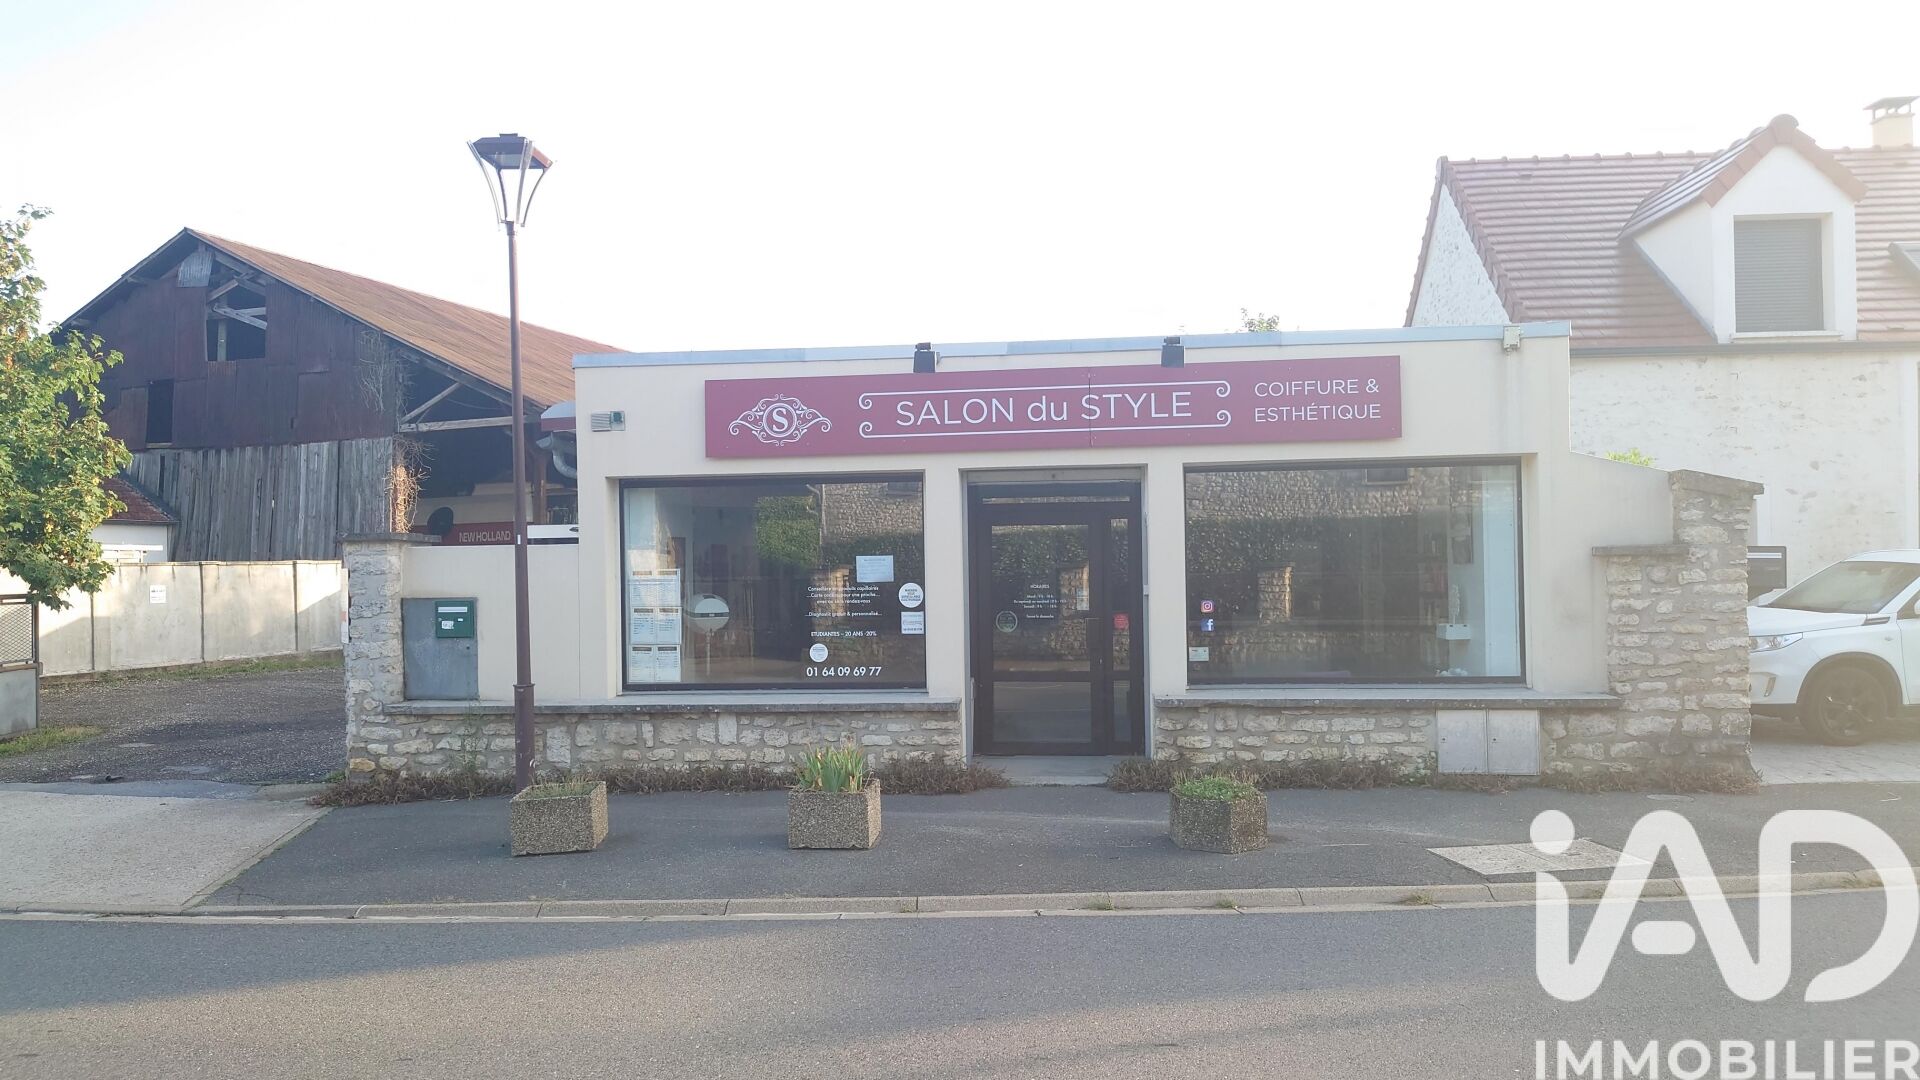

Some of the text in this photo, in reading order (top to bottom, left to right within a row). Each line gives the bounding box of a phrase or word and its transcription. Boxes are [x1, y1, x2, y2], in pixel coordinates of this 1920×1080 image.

[1254, 378, 1380, 397] COIFFURE &
[896, 391, 1192, 426] SALON du STYLE
[1254, 402, 1382, 422] ESTHÉTIQUE
[459, 530, 511, 542] NEW HOLLAND
[806, 666, 882, 677] 01 64 09 69 77
